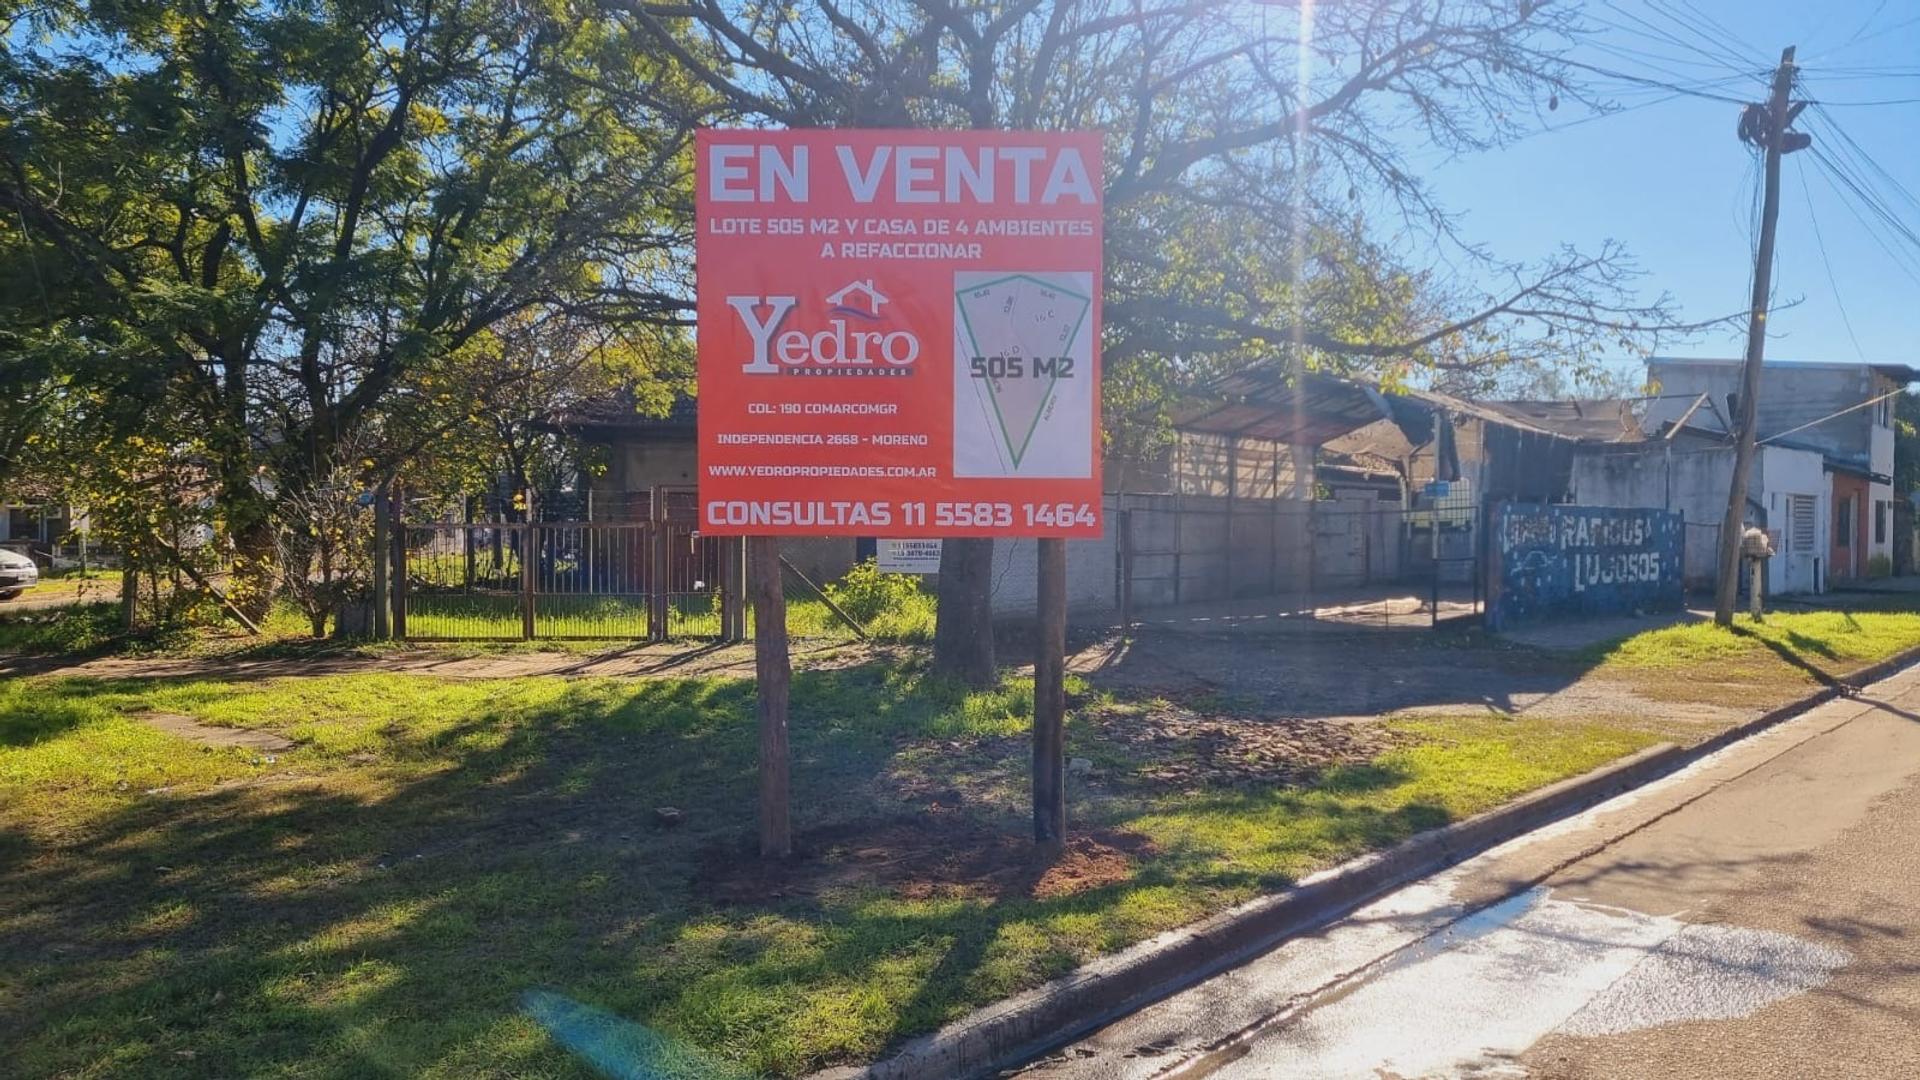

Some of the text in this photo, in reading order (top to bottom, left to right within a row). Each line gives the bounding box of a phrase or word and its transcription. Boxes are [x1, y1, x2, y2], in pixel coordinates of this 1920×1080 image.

[709, 145, 1097, 204] EN VENTA
[710, 218, 1094, 236] LOTE 505 M2 Y CASA DE 4 AMBIENTES
[821, 243, 982, 259] A REFACCIONAR
[726, 296, 919, 373] Yedro
[793, 368, 907, 376] PROPIEDADES
[970, 356, 1075, 379] 505 M2
[748, 403, 898, 415] COL: 190 COMARCOMGR
[717, 434, 823, 445] INDEPENDENCIA
[827, 434, 859, 445] 2668
[872, 434, 928, 446] MORENO
[709, 465, 937, 478] WWW.YEDROPROPIEDADES.COM.AR
[707, 501, 1096, 527] CONSULTAS 11 5583 1464
